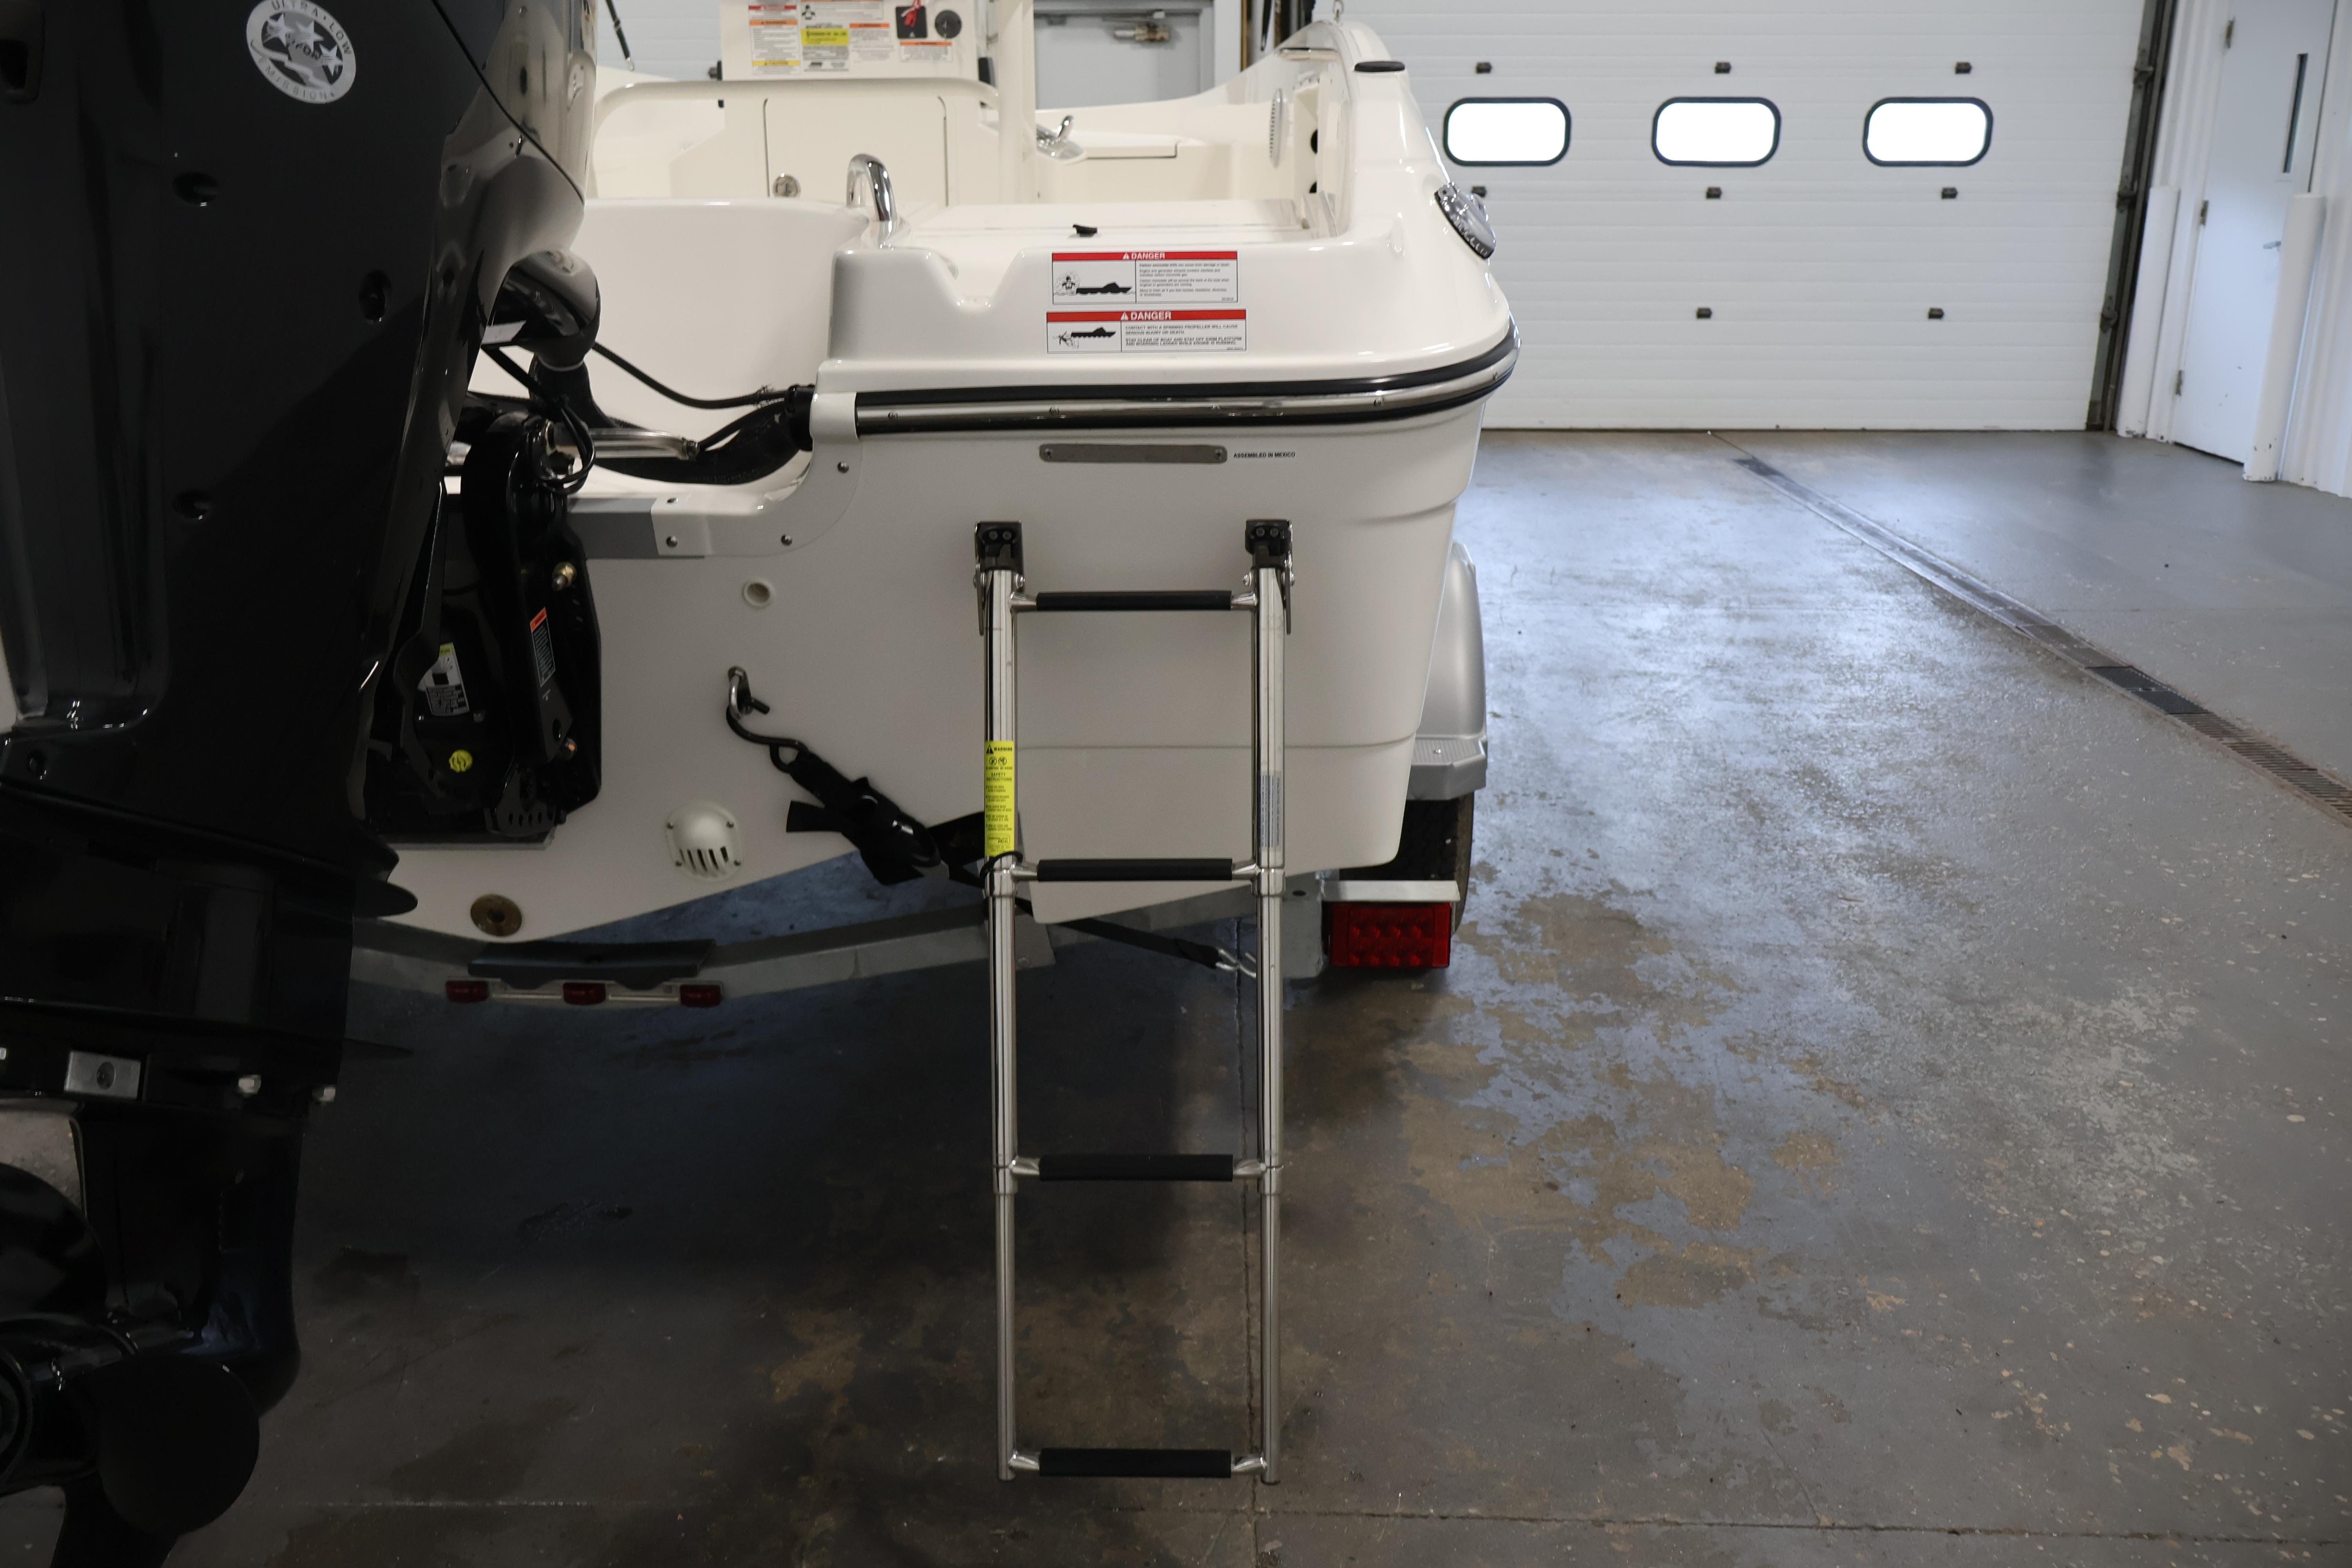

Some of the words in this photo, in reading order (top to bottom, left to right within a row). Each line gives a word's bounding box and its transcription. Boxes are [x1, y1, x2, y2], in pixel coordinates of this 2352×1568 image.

[271, 0, 318, 17] ULTRA
[329, 21, 352, 54] LOW
[1131, 311, 1171, 321] DANGER
